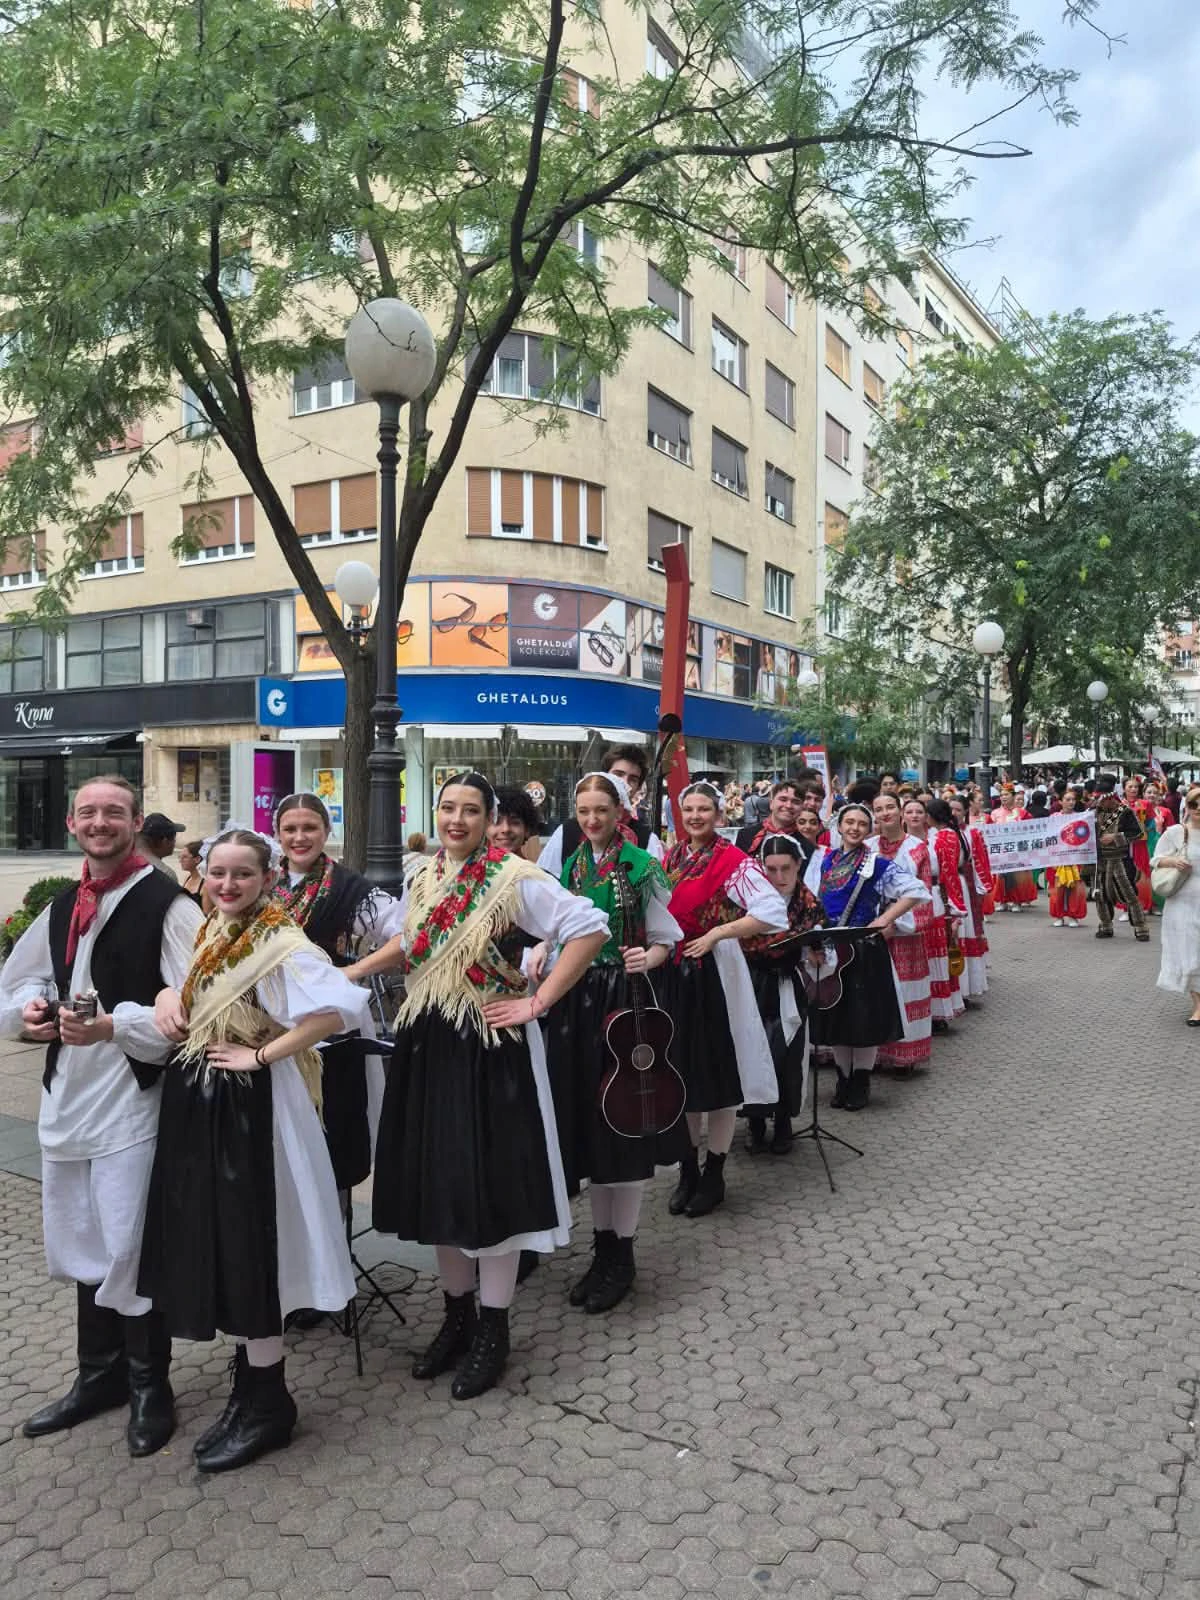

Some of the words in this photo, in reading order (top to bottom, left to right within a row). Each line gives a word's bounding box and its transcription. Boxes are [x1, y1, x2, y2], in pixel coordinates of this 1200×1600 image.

[516, 637, 573, 649] GHETALDUS
[519, 647, 571, 657] KOLEKCIJA
[267, 688, 287, 716] G
[476, 692, 568, 705] GHETALDUS
[15, 702, 54, 729] Krona
[985, 835, 1059, 854] 西亞藝術節
